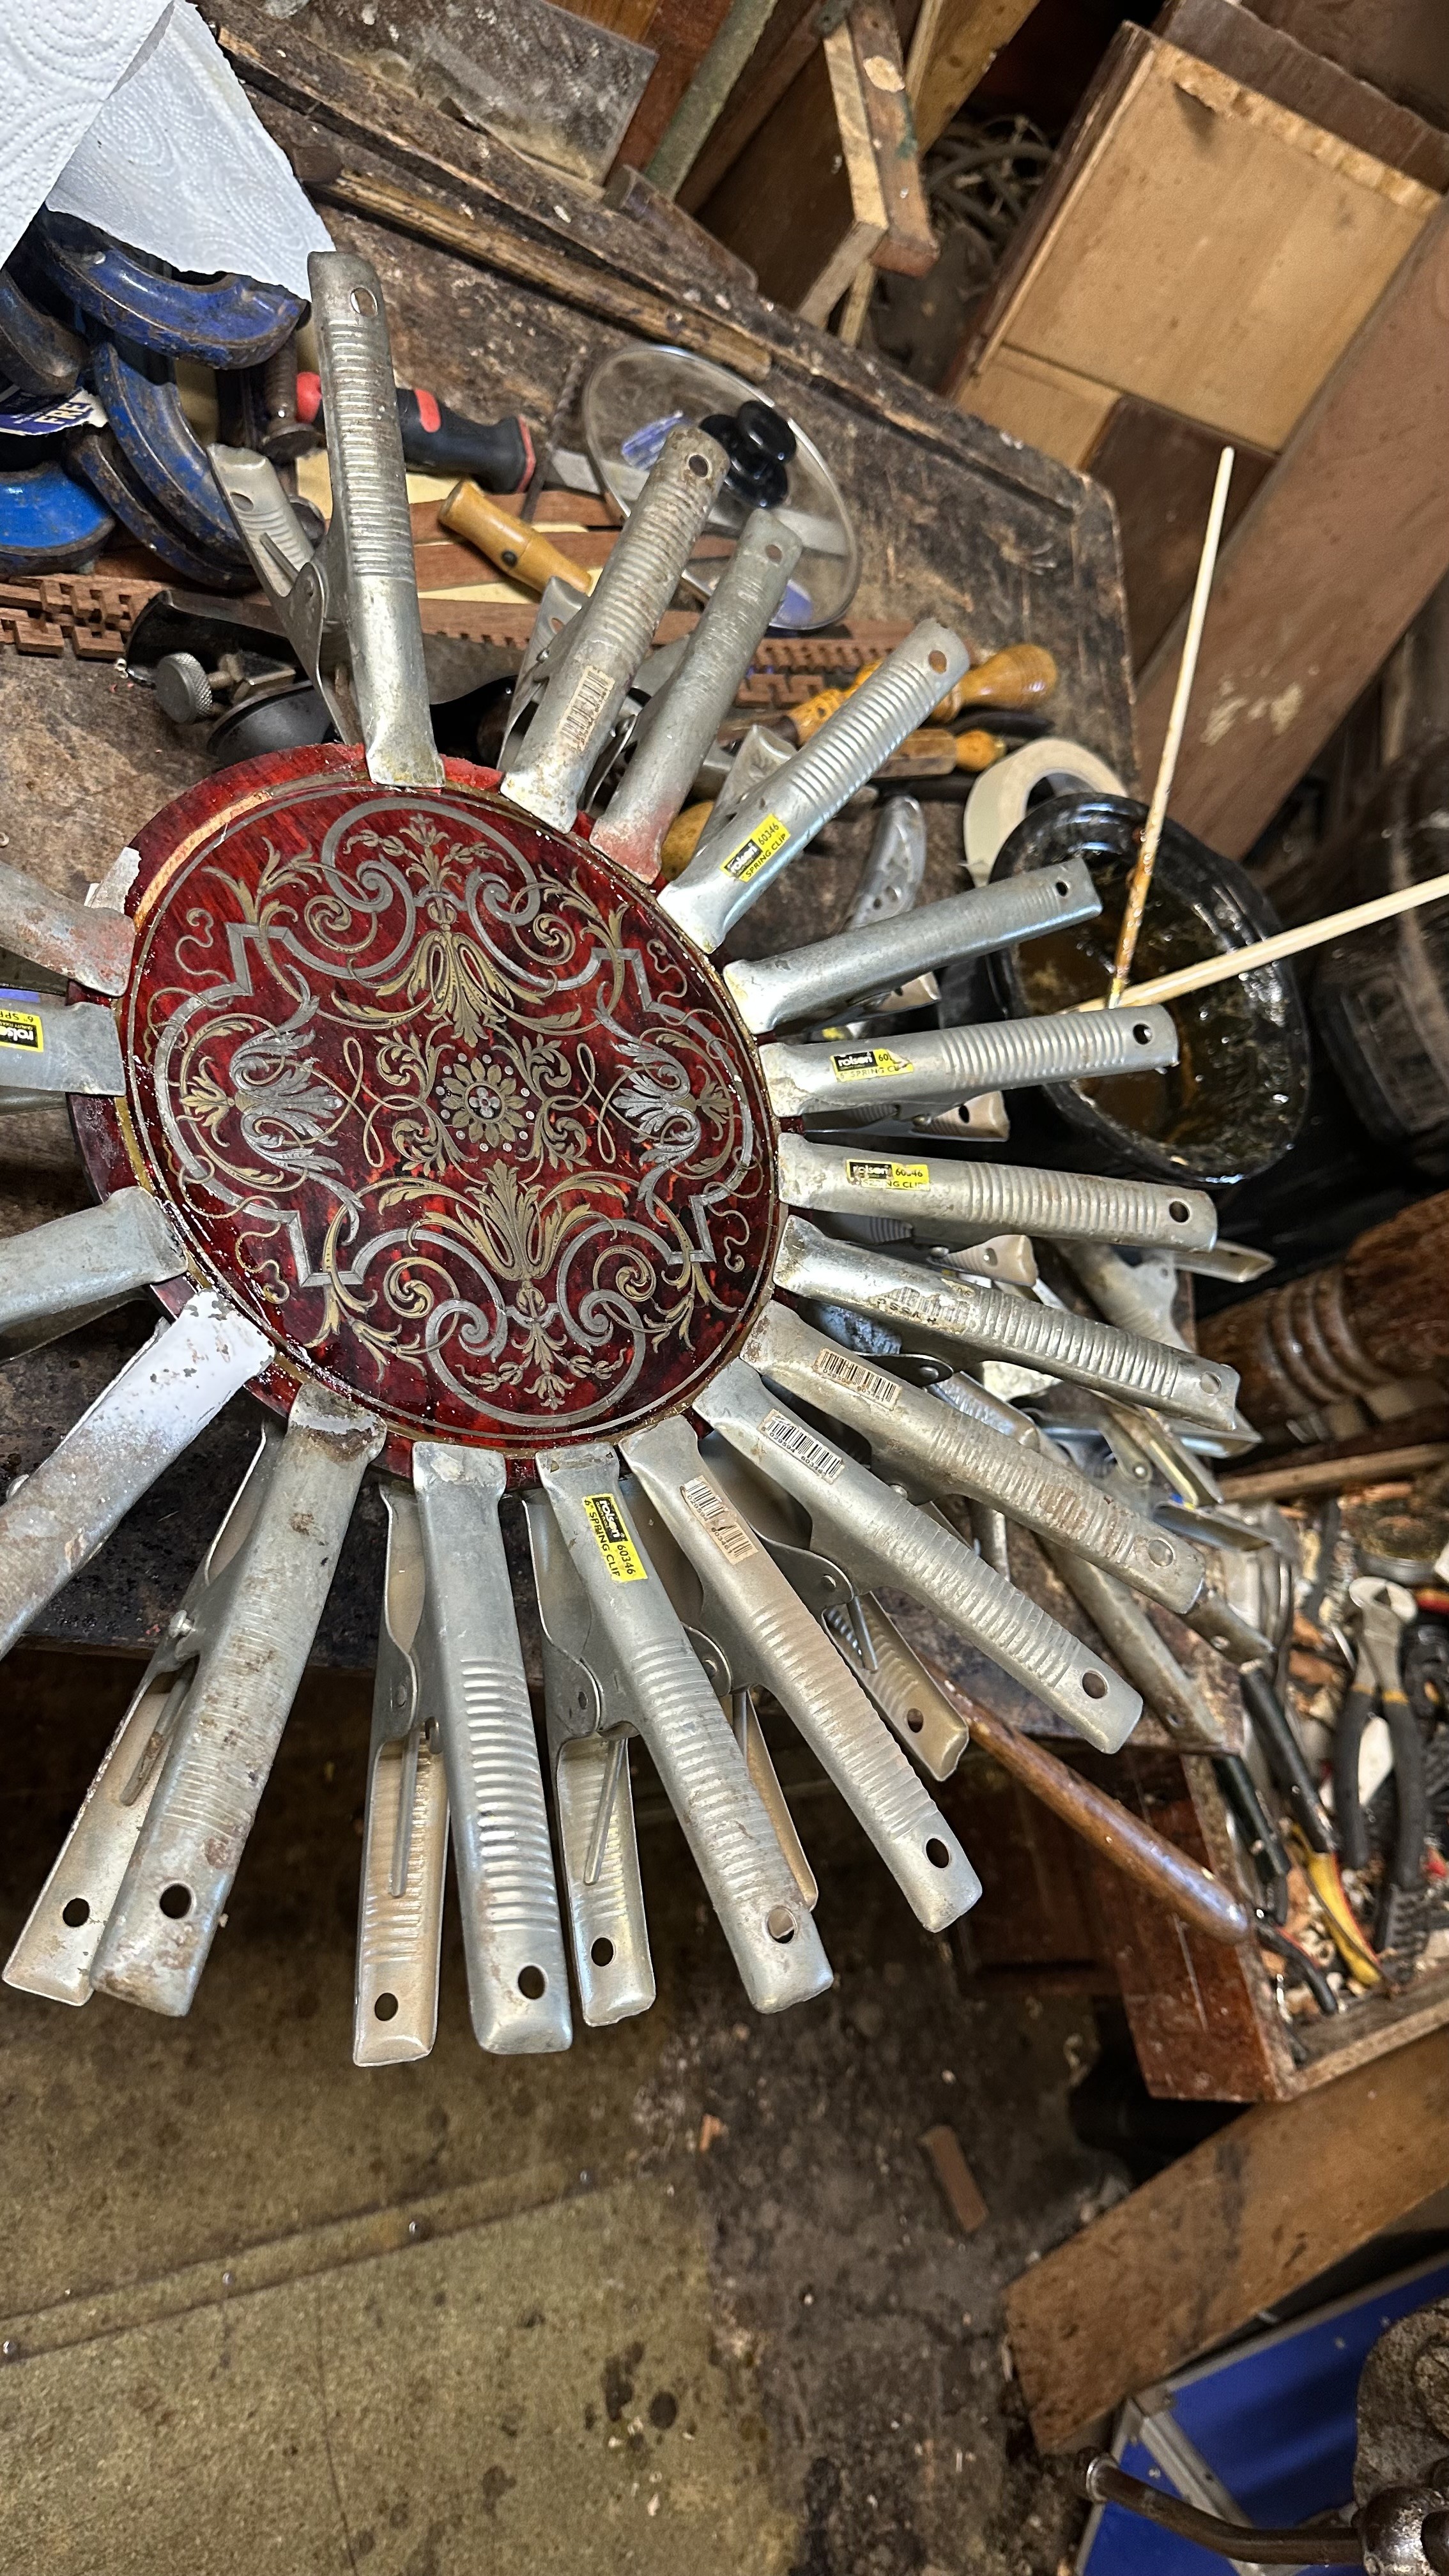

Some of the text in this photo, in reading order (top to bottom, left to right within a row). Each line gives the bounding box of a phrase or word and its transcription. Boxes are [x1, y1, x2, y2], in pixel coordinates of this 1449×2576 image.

[758, 823, 779, 845] 60346
[746, 849, 772, 878] SPRING
[771, 833, 786, 850] CLIP
[838, 1055, 873, 1067] rolson
[769, 1432, 795, 1453] 029594
[589, 1512, 610, 1551] SPRING
[599, 1500, 636, 1575] rolson 60346
